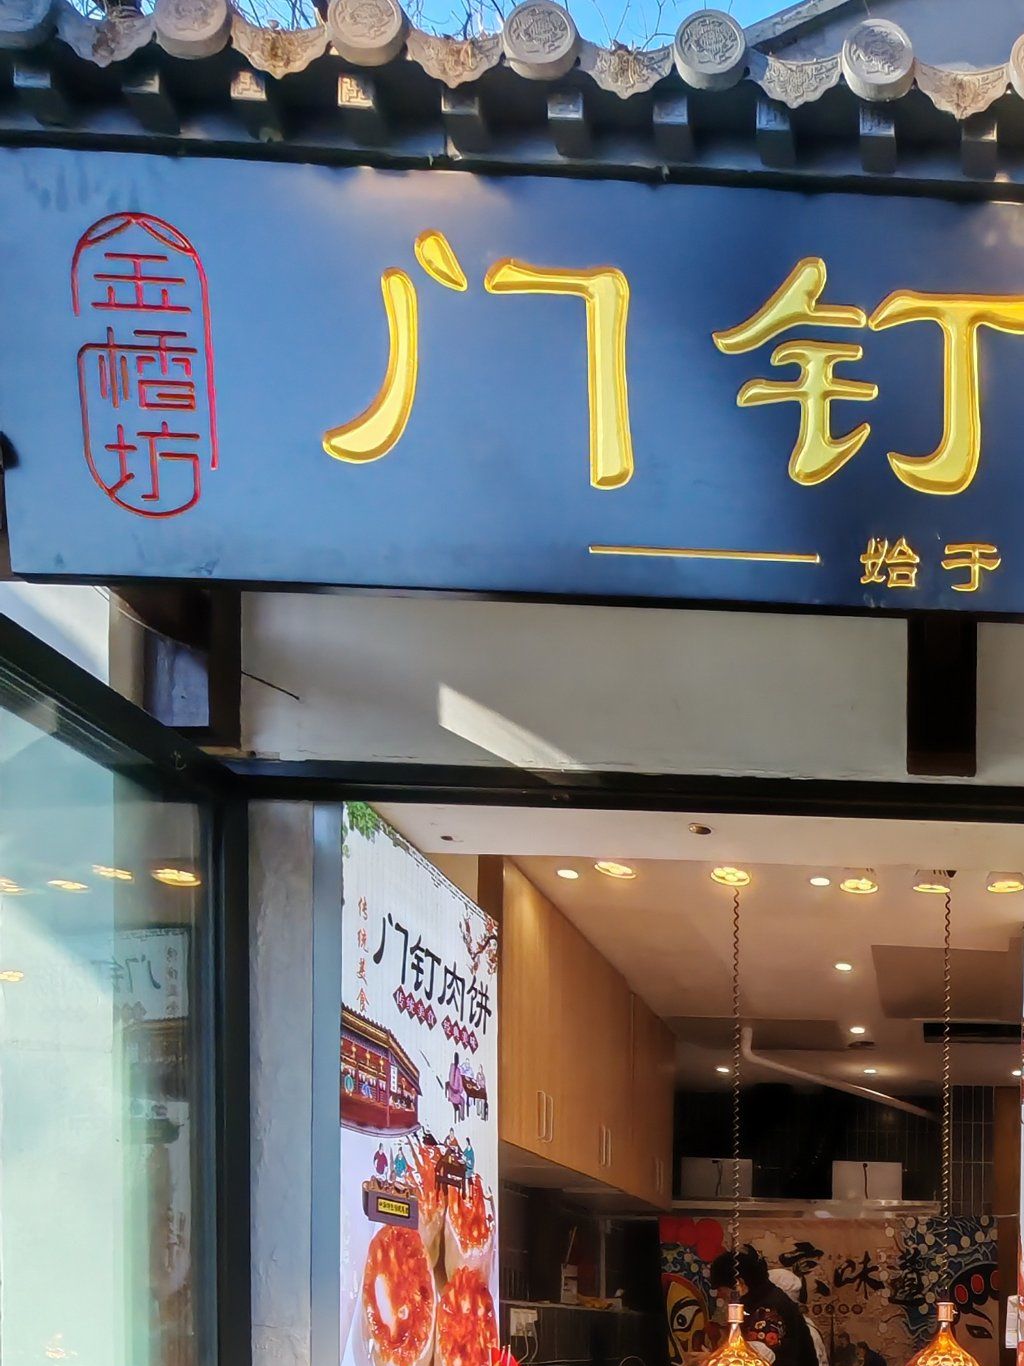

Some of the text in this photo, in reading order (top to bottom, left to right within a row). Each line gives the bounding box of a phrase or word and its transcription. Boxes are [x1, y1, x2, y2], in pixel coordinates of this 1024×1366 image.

[859, 536, 1002, 591] 始于
[356, 896, 371, 1013] 传统美食
[373, 912, 492, 1036] 门钉肉饼
